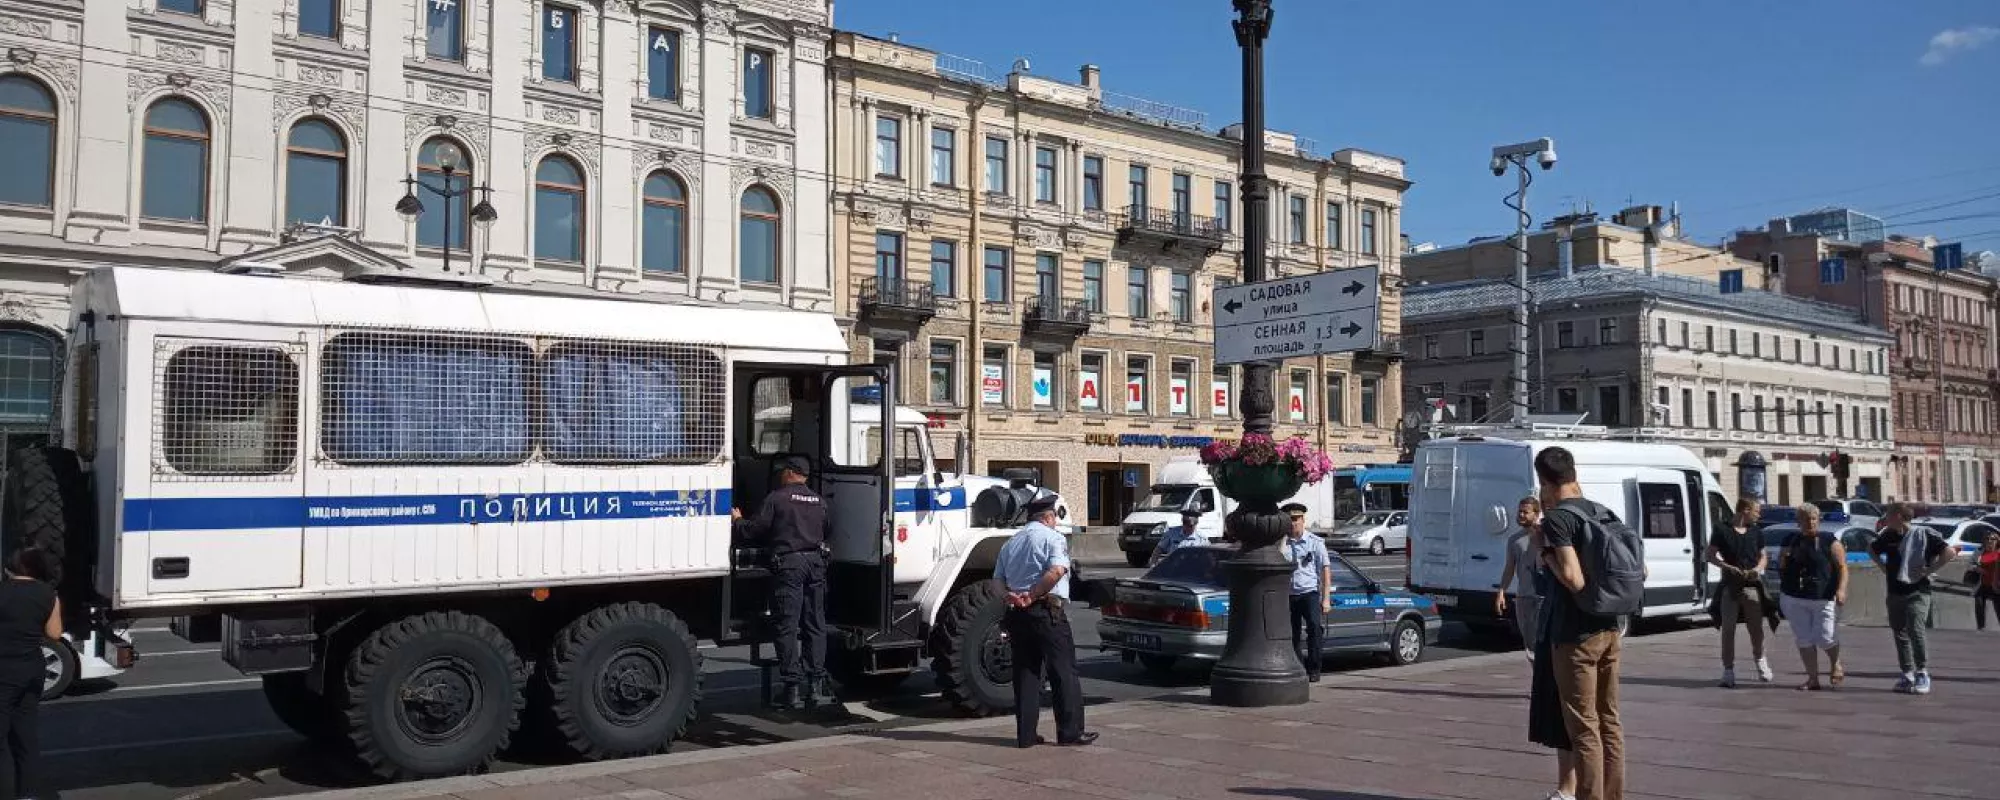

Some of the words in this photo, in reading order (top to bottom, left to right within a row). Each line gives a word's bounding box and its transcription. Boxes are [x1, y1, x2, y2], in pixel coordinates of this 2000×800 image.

[1250, 280, 1312, 301] САДОВАЯ
[1263, 303, 1298, 318] улица
[1254, 321, 1306, 339] СЕННАЯ
[1254, 342, 1304, 355] площадь
[460, 496, 621, 519] ПОЛИЦИЯ
